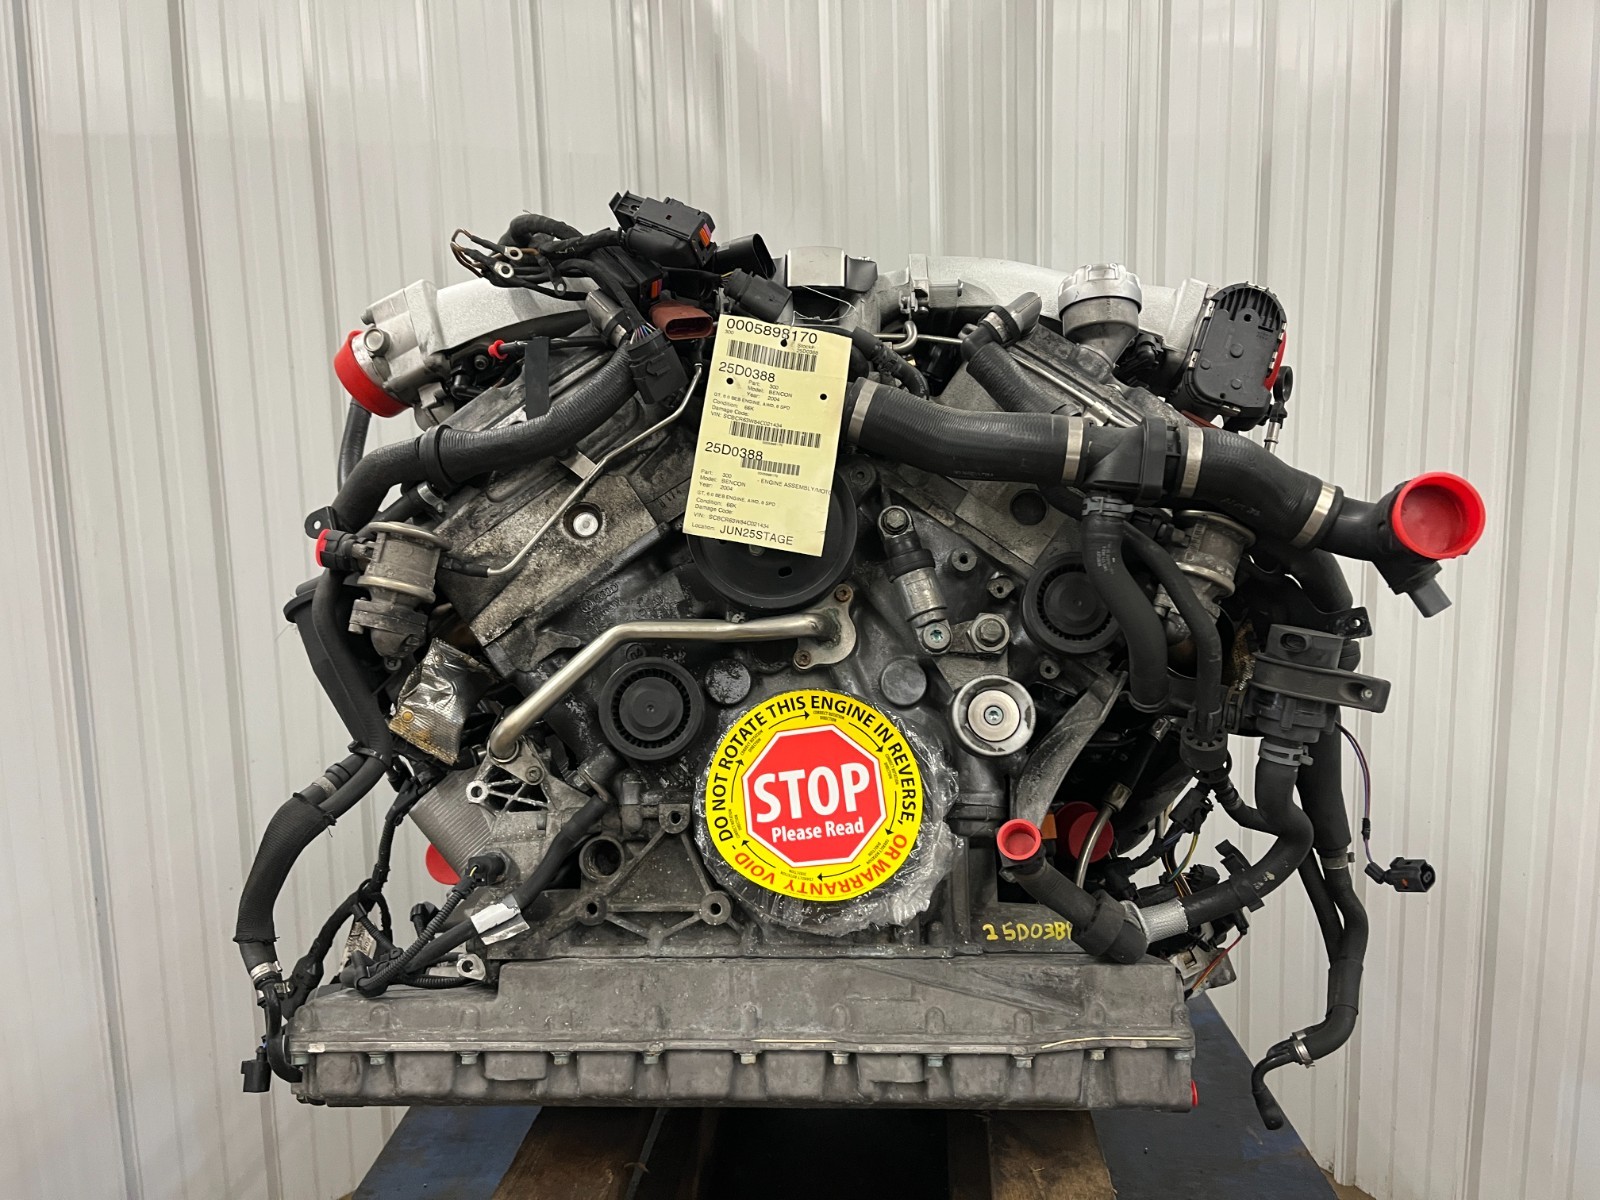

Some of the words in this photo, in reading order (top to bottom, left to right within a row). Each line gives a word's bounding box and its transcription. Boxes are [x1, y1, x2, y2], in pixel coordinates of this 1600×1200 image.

[727, 319, 817, 344] 0005898170
[719, 362, 775, 382] 25D0388
[712, 405, 733, 413] Damage
[713, 398, 738, 408] Condition:
[705, 442, 763, 462] 25D0388
[721, 479, 746, 487] BENCON
[695, 504, 717, 512] Damage
[696, 497, 722, 506] Condition:
[692, 522, 715, 530] Location:
[720, 526, 793, 545] JUN25STAGE
[766, 696, 805, 718] THIS
[811, 696, 875, 727] ENGINE
[723, 711, 767, 770] ROTATE
[874, 723, 894, 743] IN
[712, 773, 727, 811] NOT
[752, 762, 870, 823] STOP
[889, 743, 916, 824] REVERSE,
[714, 816, 734, 842] DO
[771, 826, 823, 843] Please
[824, 817, 865, 837] Read
[887, 834, 908, 861] OR
[735, 852, 775, 885] VOID
[783, 858, 891, 896] WARRANTY
